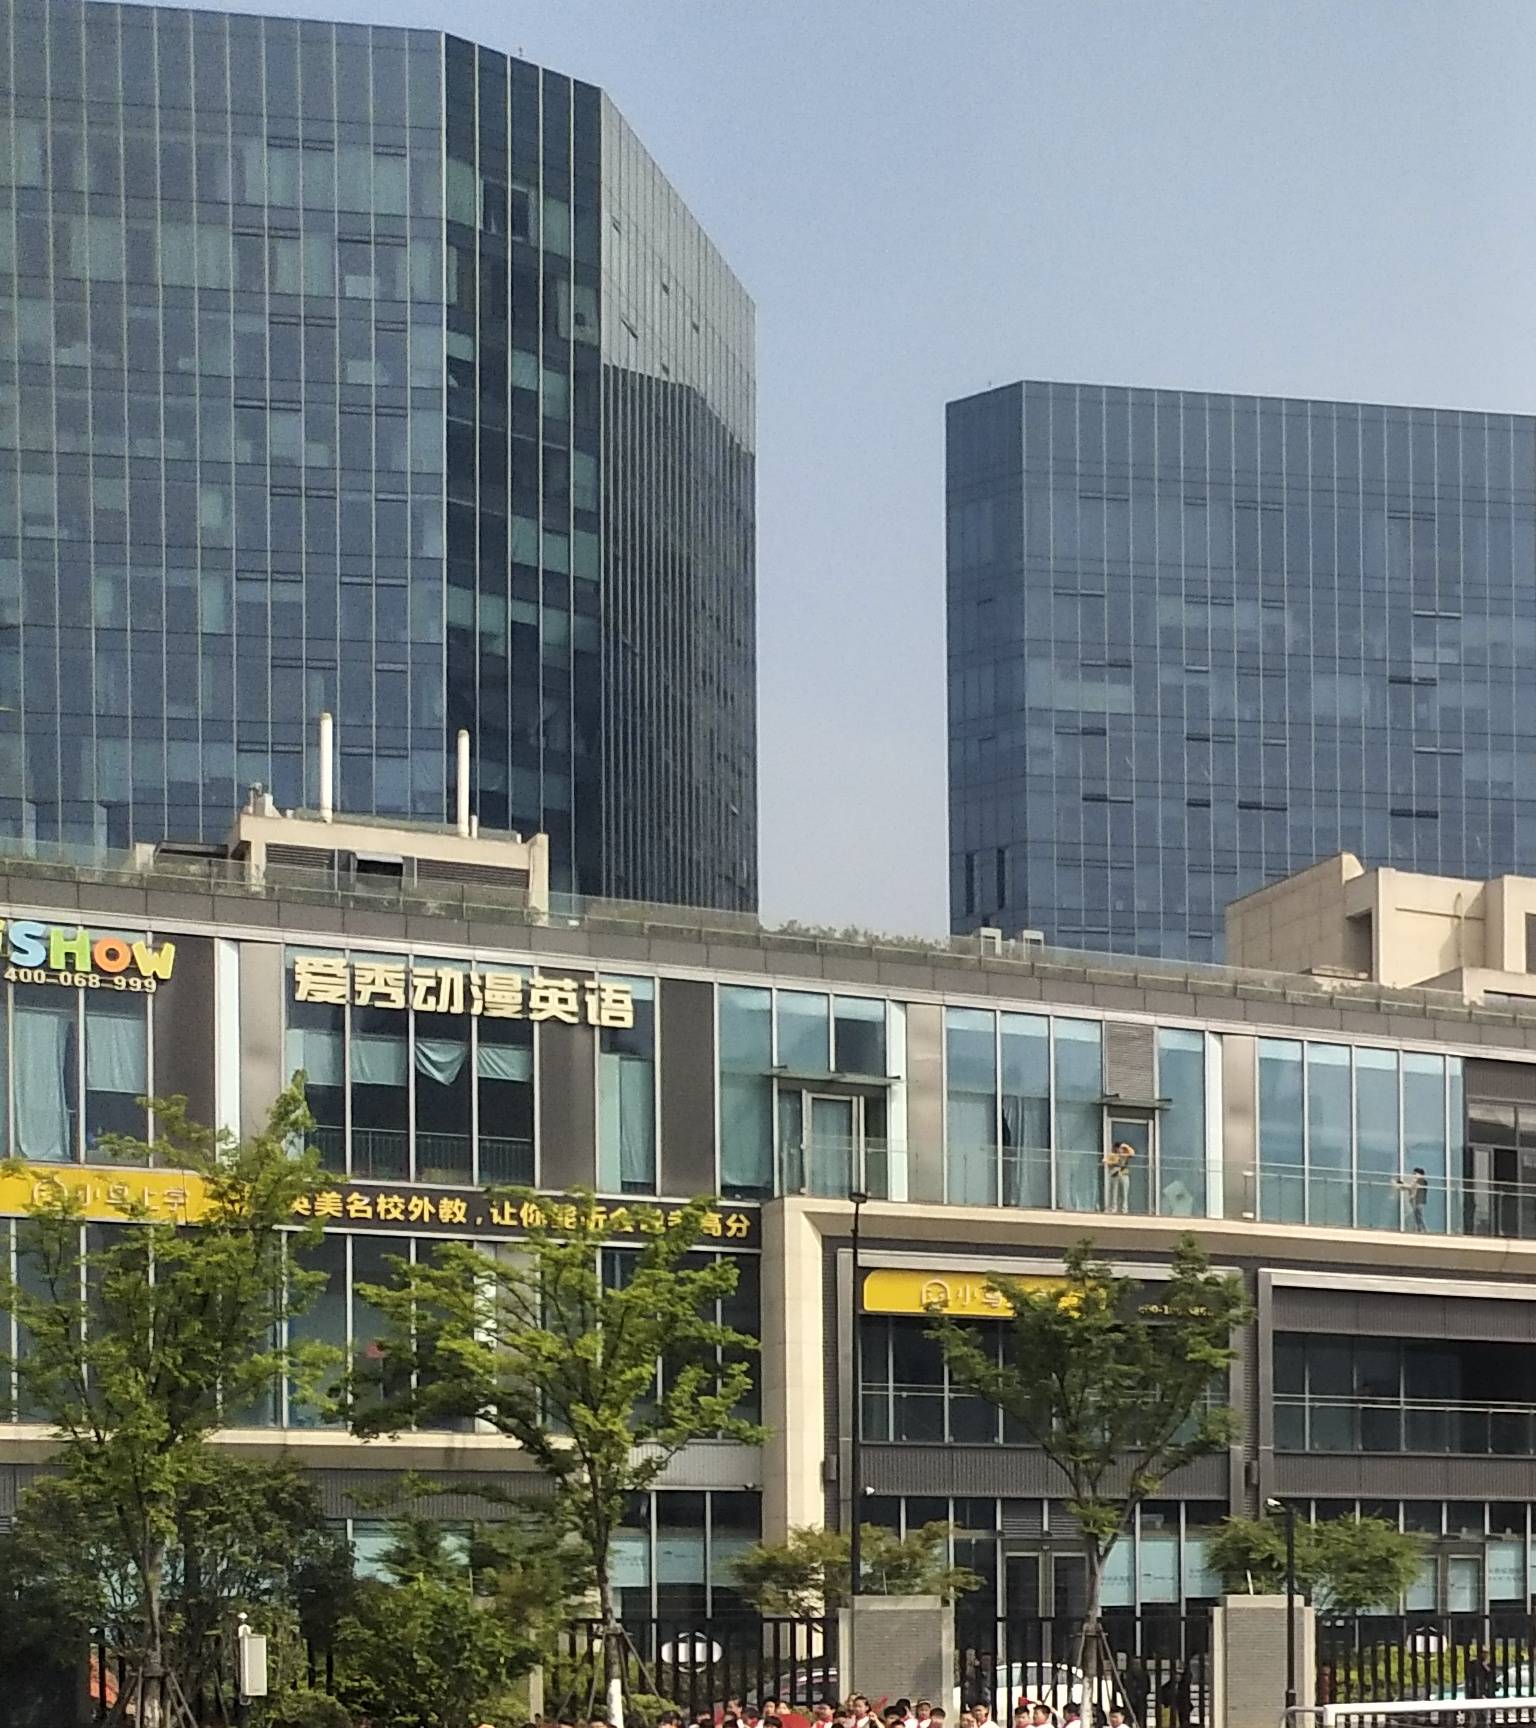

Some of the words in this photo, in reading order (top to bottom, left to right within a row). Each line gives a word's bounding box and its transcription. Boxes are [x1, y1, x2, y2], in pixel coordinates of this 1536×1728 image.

[294, 955, 634, 1028] 爱秀动漫英语
